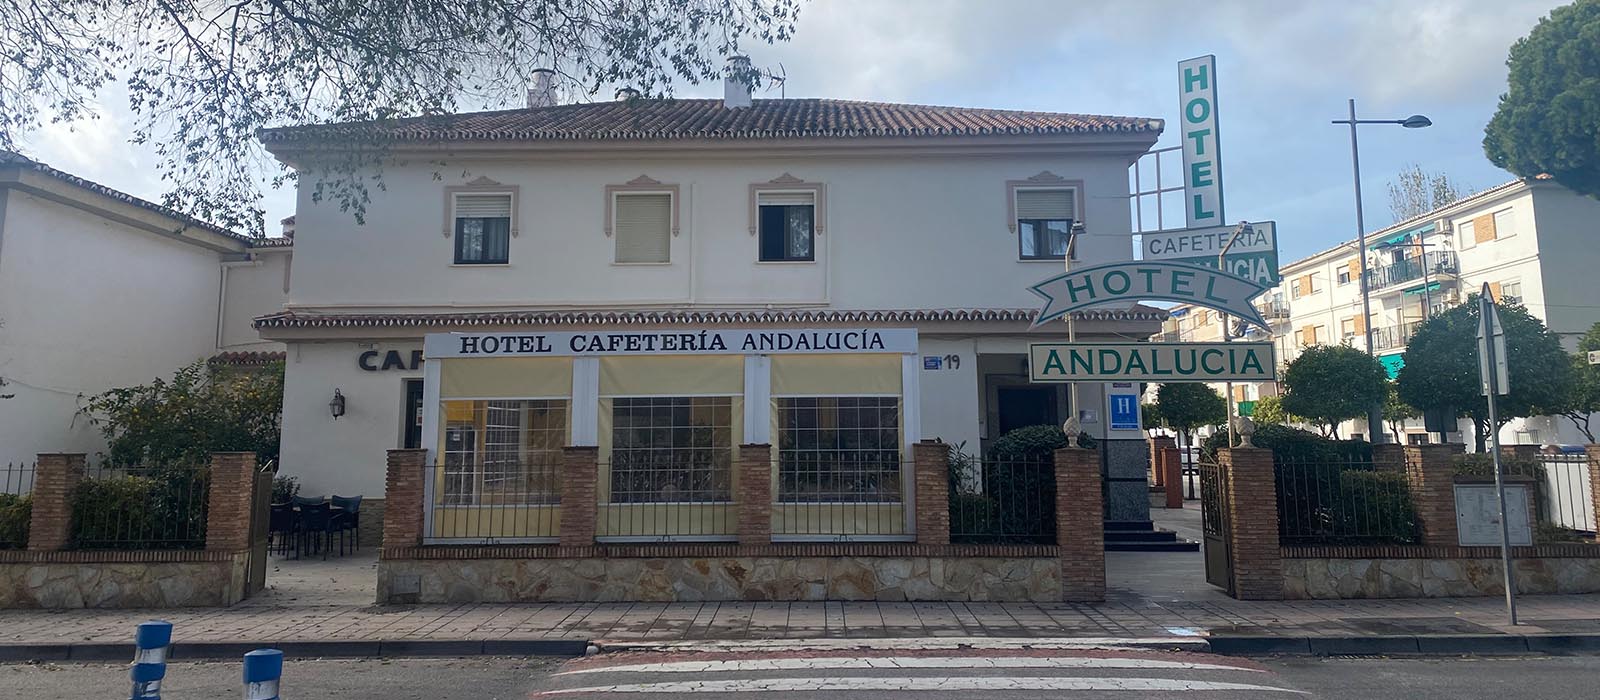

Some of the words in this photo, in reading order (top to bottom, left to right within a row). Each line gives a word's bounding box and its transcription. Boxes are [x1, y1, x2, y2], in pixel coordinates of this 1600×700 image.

[1184, 64, 1215, 220] HOTEL
[1065, 268, 1228, 303] HOTEL
[459, 336, 552, 354] HOTEL
[569, 330, 727, 352] CAFETERÍA
[741, 328, 885, 351] ANDALUCÍA
[943, 354, 960, 370] 19
[1042, 348, 1265, 375] ANDALUCIA
[1117, 397, 1130, 414] H
